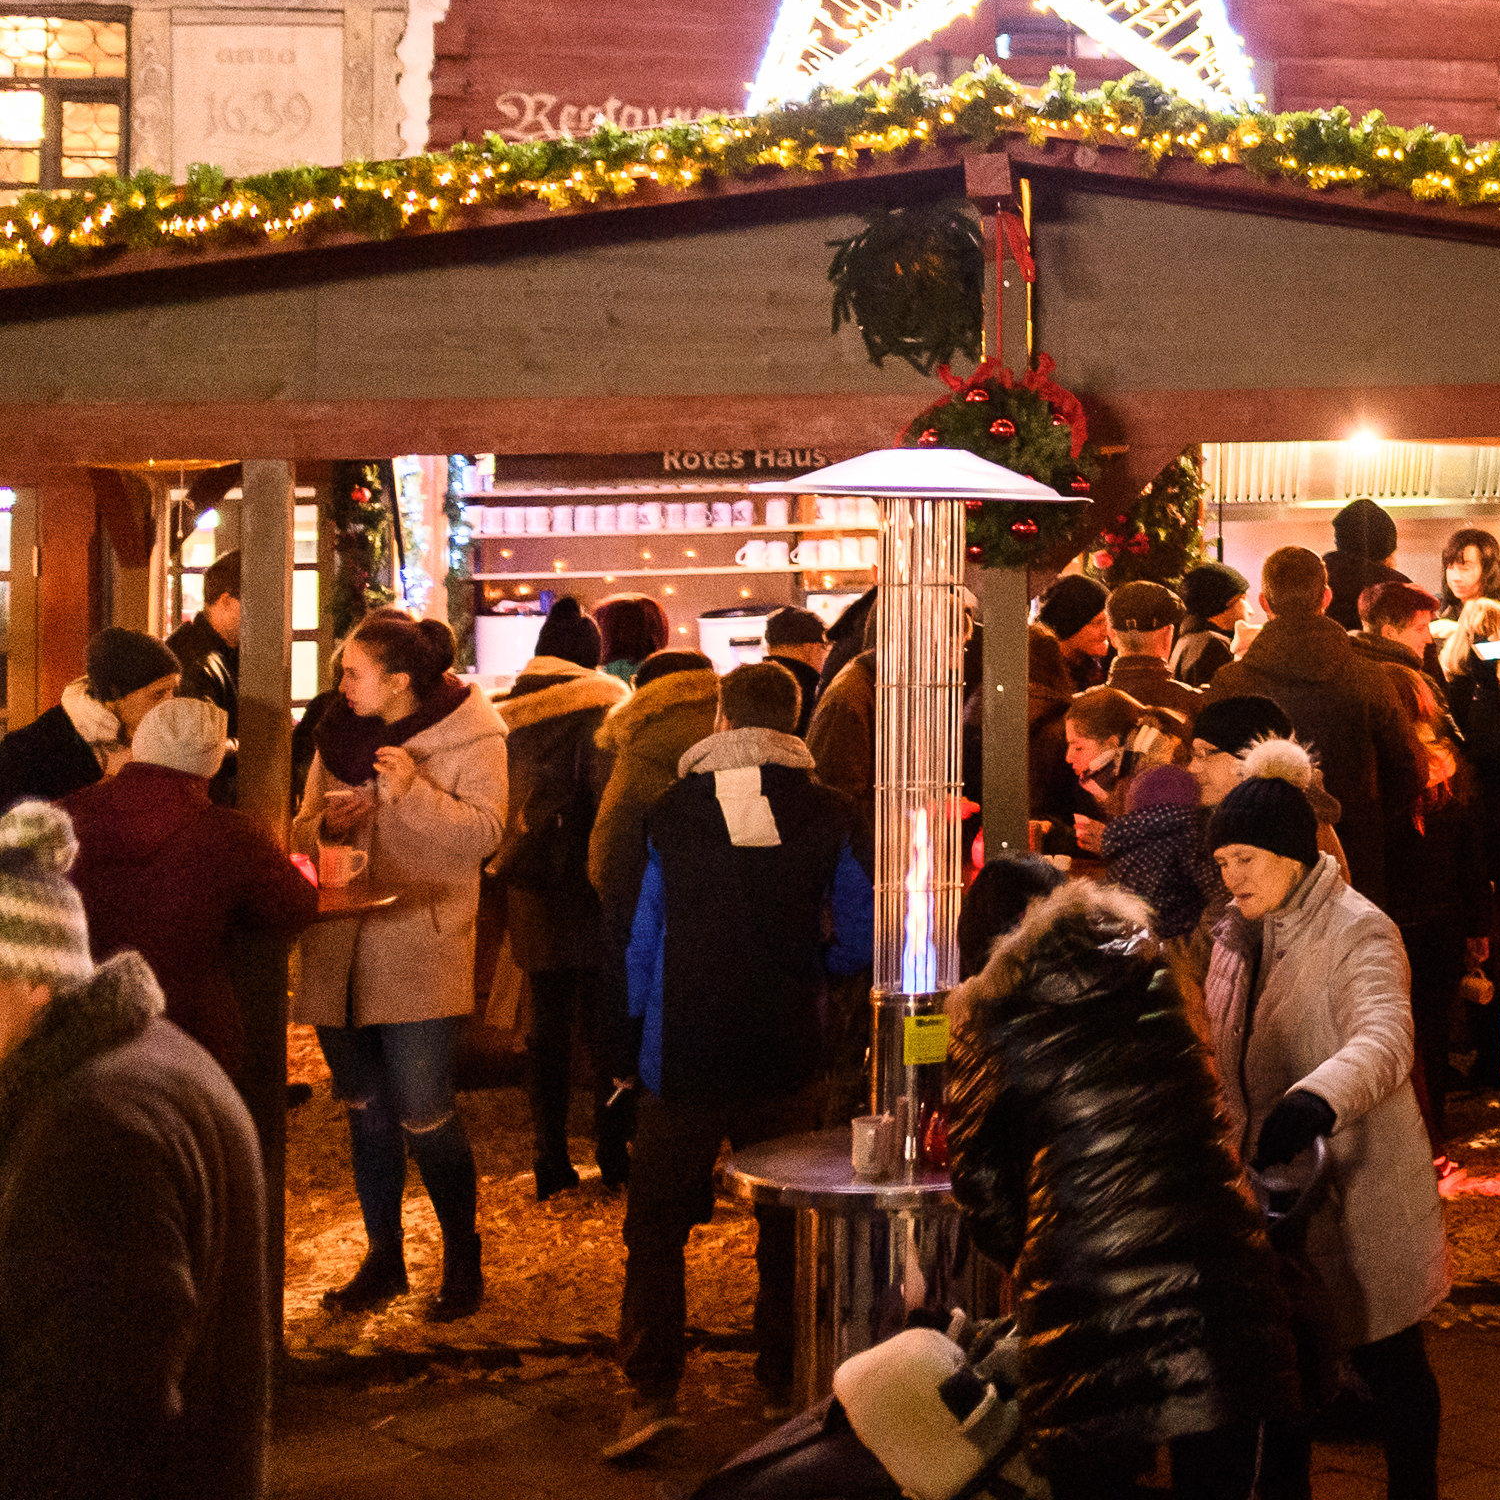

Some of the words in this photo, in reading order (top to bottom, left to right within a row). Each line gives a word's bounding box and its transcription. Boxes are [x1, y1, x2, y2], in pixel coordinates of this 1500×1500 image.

[206, 89, 312, 140] 1639
[663, 449, 745, 470] Rotes
[755, 449, 825, 468] Haus
